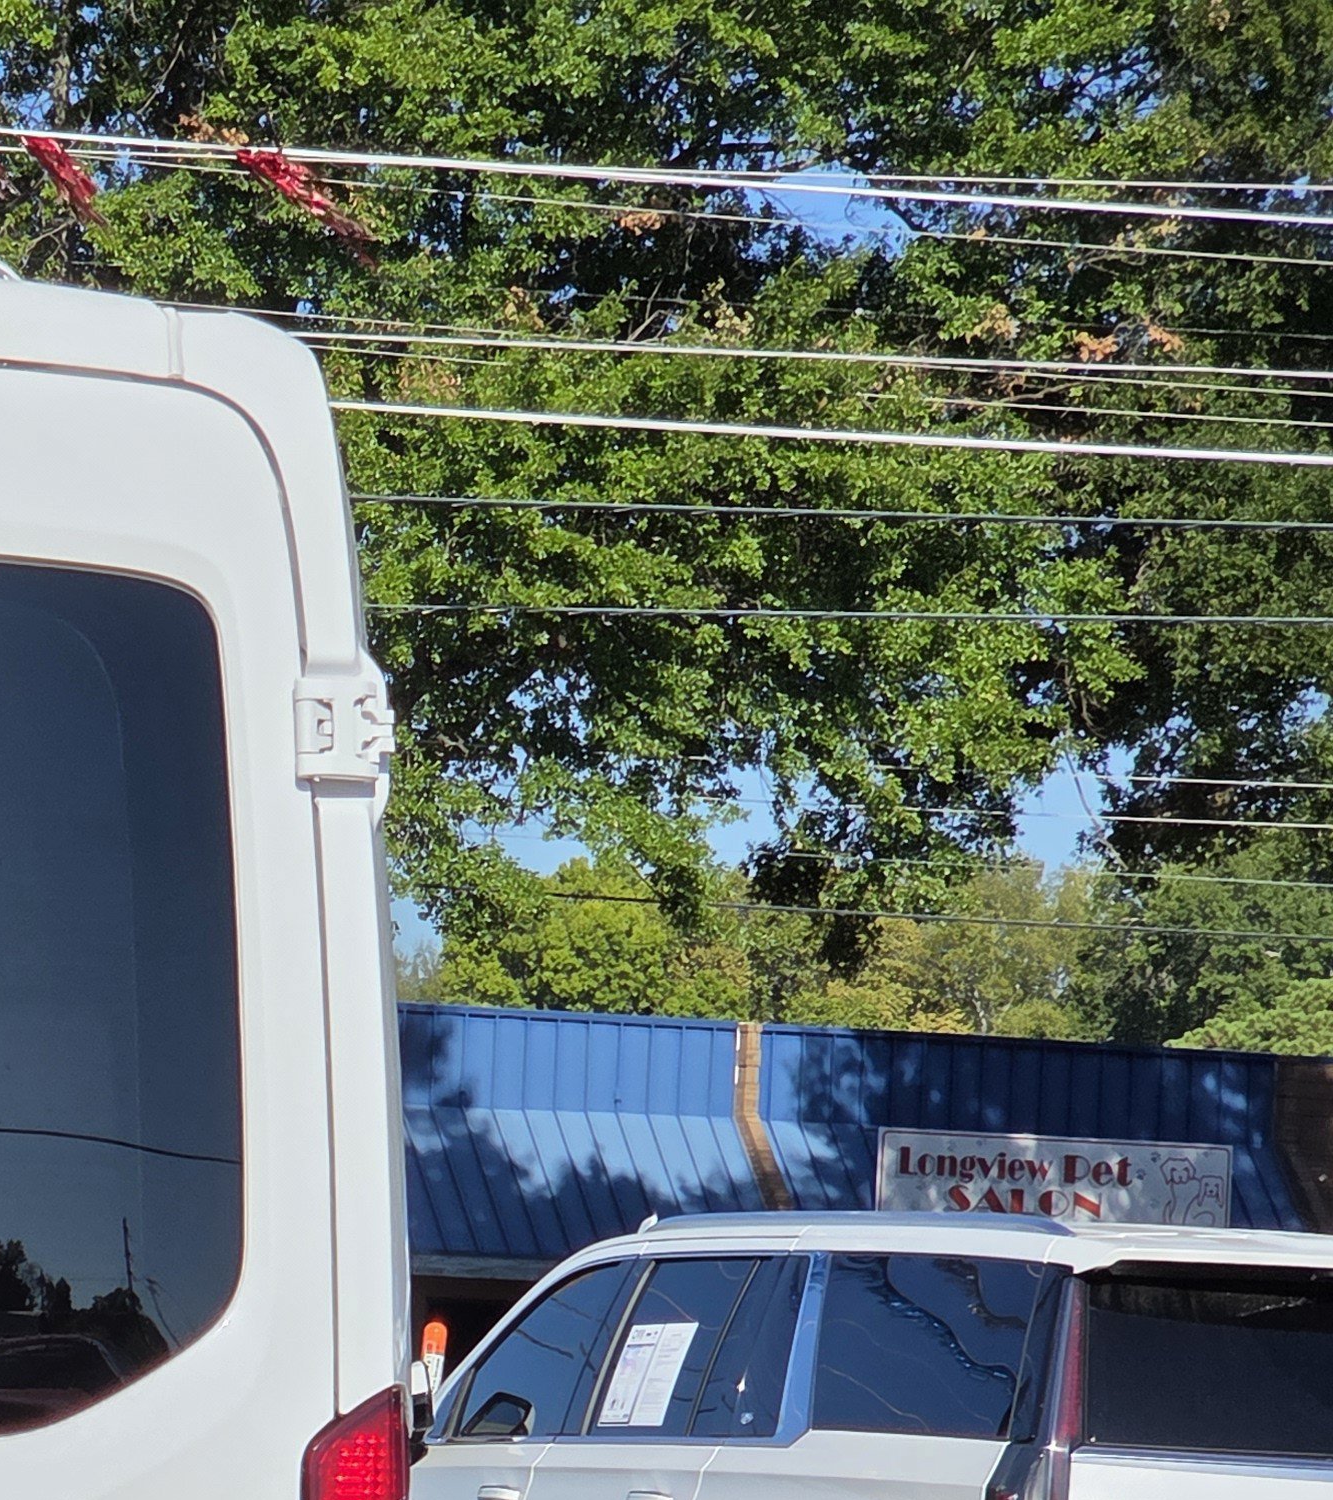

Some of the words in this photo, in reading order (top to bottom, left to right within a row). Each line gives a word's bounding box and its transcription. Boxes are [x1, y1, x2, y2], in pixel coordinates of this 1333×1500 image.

[899, 1146, 1053, 1183] Longview
[1063, 1154, 1133, 1188] Pet
[948, 1184, 1103, 1219] SALON
